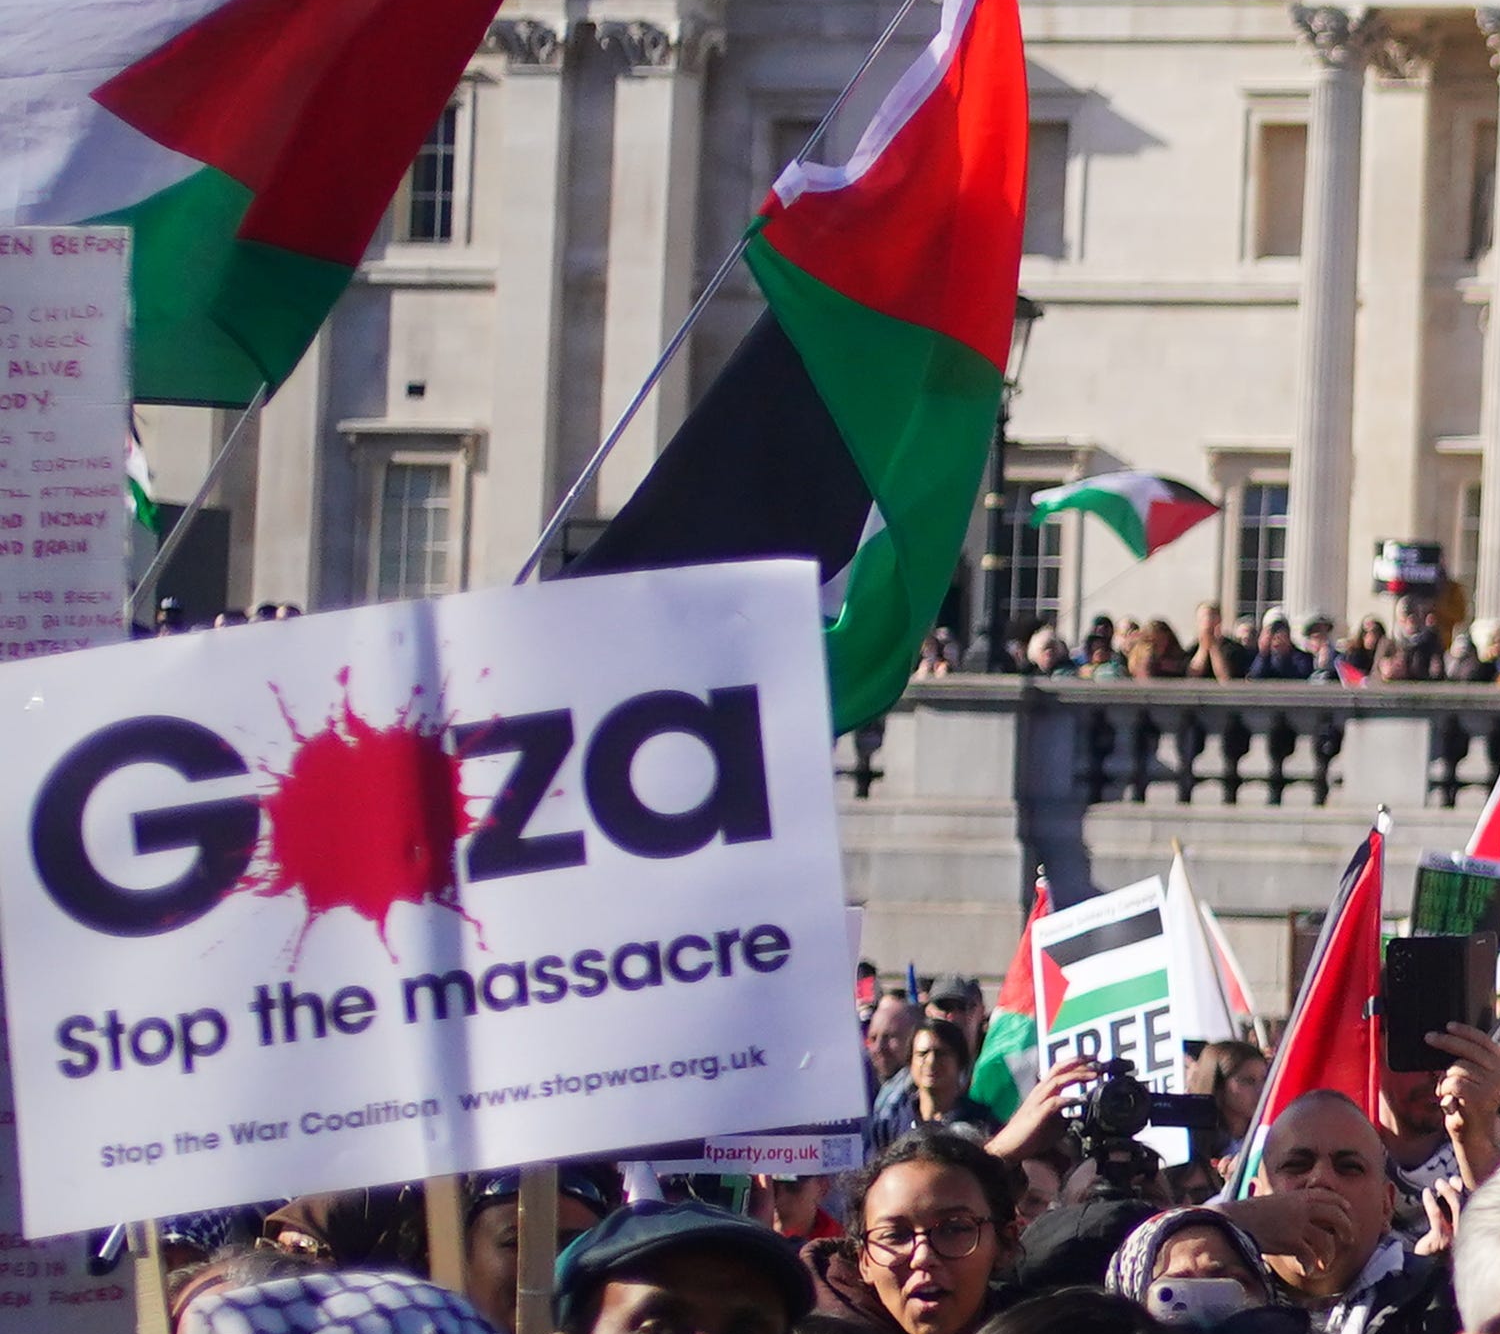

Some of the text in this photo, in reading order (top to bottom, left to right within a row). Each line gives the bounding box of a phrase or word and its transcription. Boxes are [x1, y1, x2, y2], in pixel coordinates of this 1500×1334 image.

[30, 684, 772, 938] Gza
[56, 923, 792, 1079] Stop the massacre
[100, 1043, 766, 1168] Stop the War Coalition www.stopwar.org.uk
